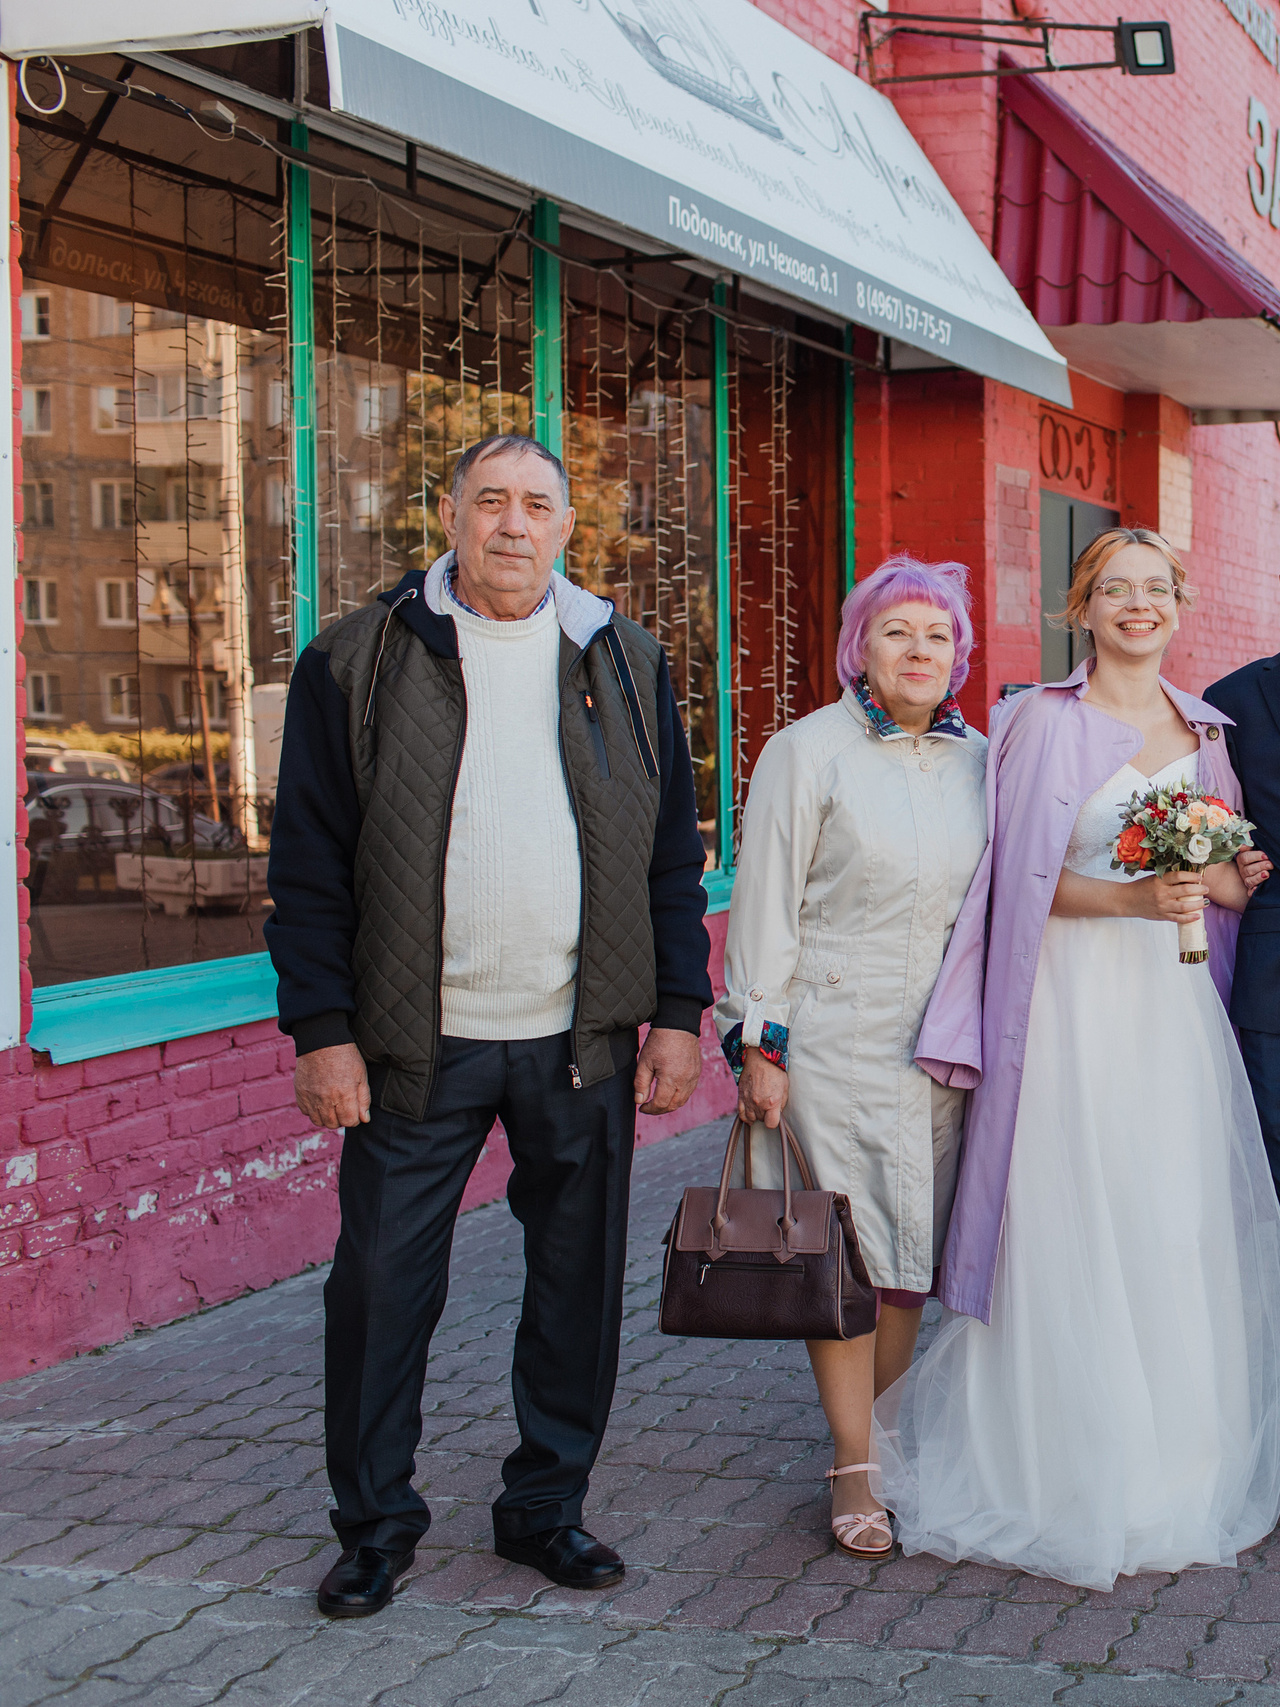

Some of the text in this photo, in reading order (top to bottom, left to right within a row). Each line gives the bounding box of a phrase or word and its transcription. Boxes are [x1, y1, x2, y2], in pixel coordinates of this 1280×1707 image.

[668, 195, 747, 261] Подольск,
[856, 281, 952, 346] 8 (4967) 57-75-57
